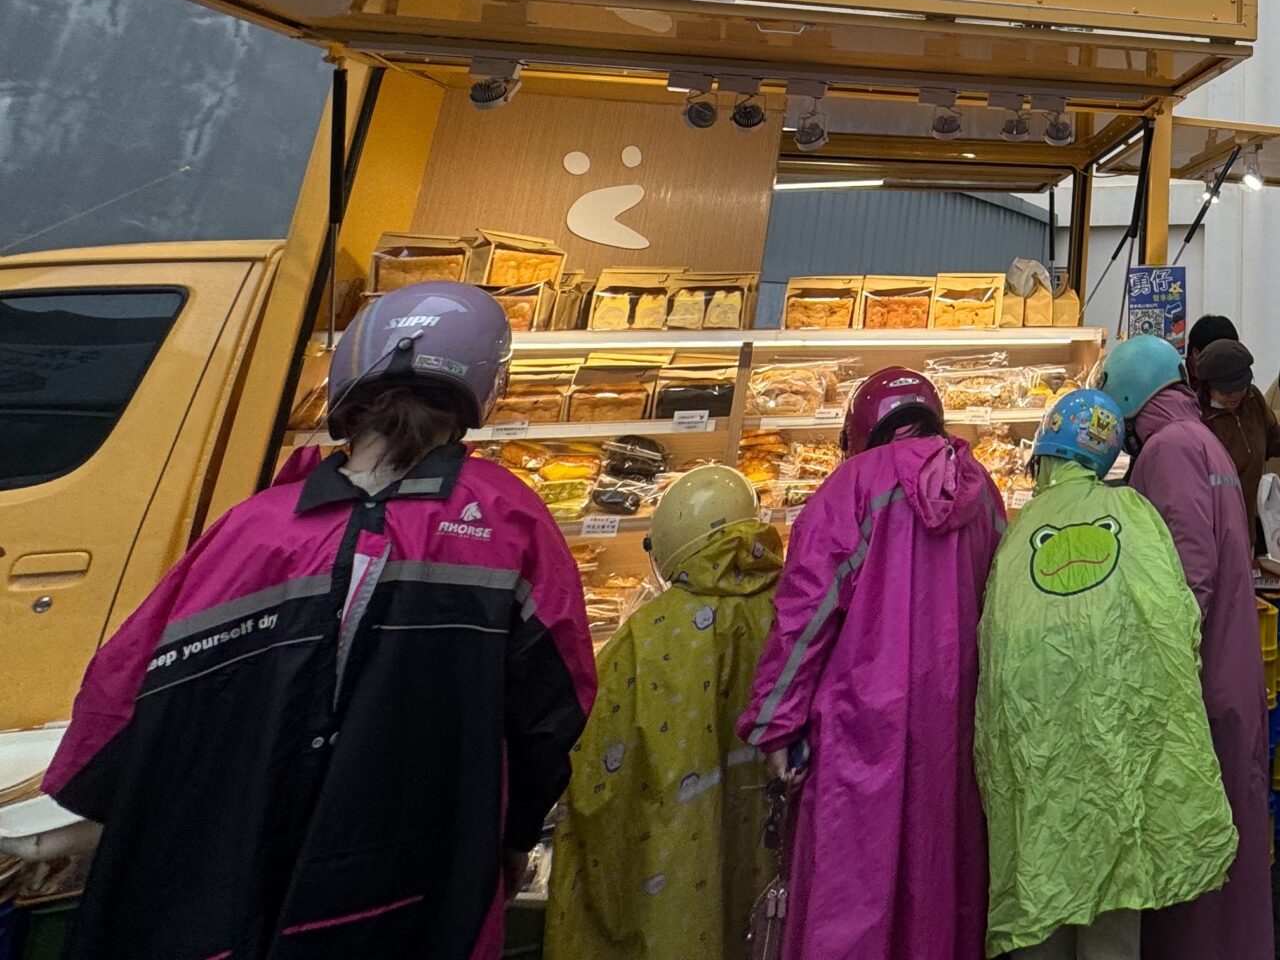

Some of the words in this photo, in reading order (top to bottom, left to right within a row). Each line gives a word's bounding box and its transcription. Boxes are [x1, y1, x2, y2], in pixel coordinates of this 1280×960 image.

[1128, 269, 1173, 297] 勇仔
[147, 649, 178, 672] eep
[182, 618, 254, 660] yourself
[258, 613, 279, 630] dry
